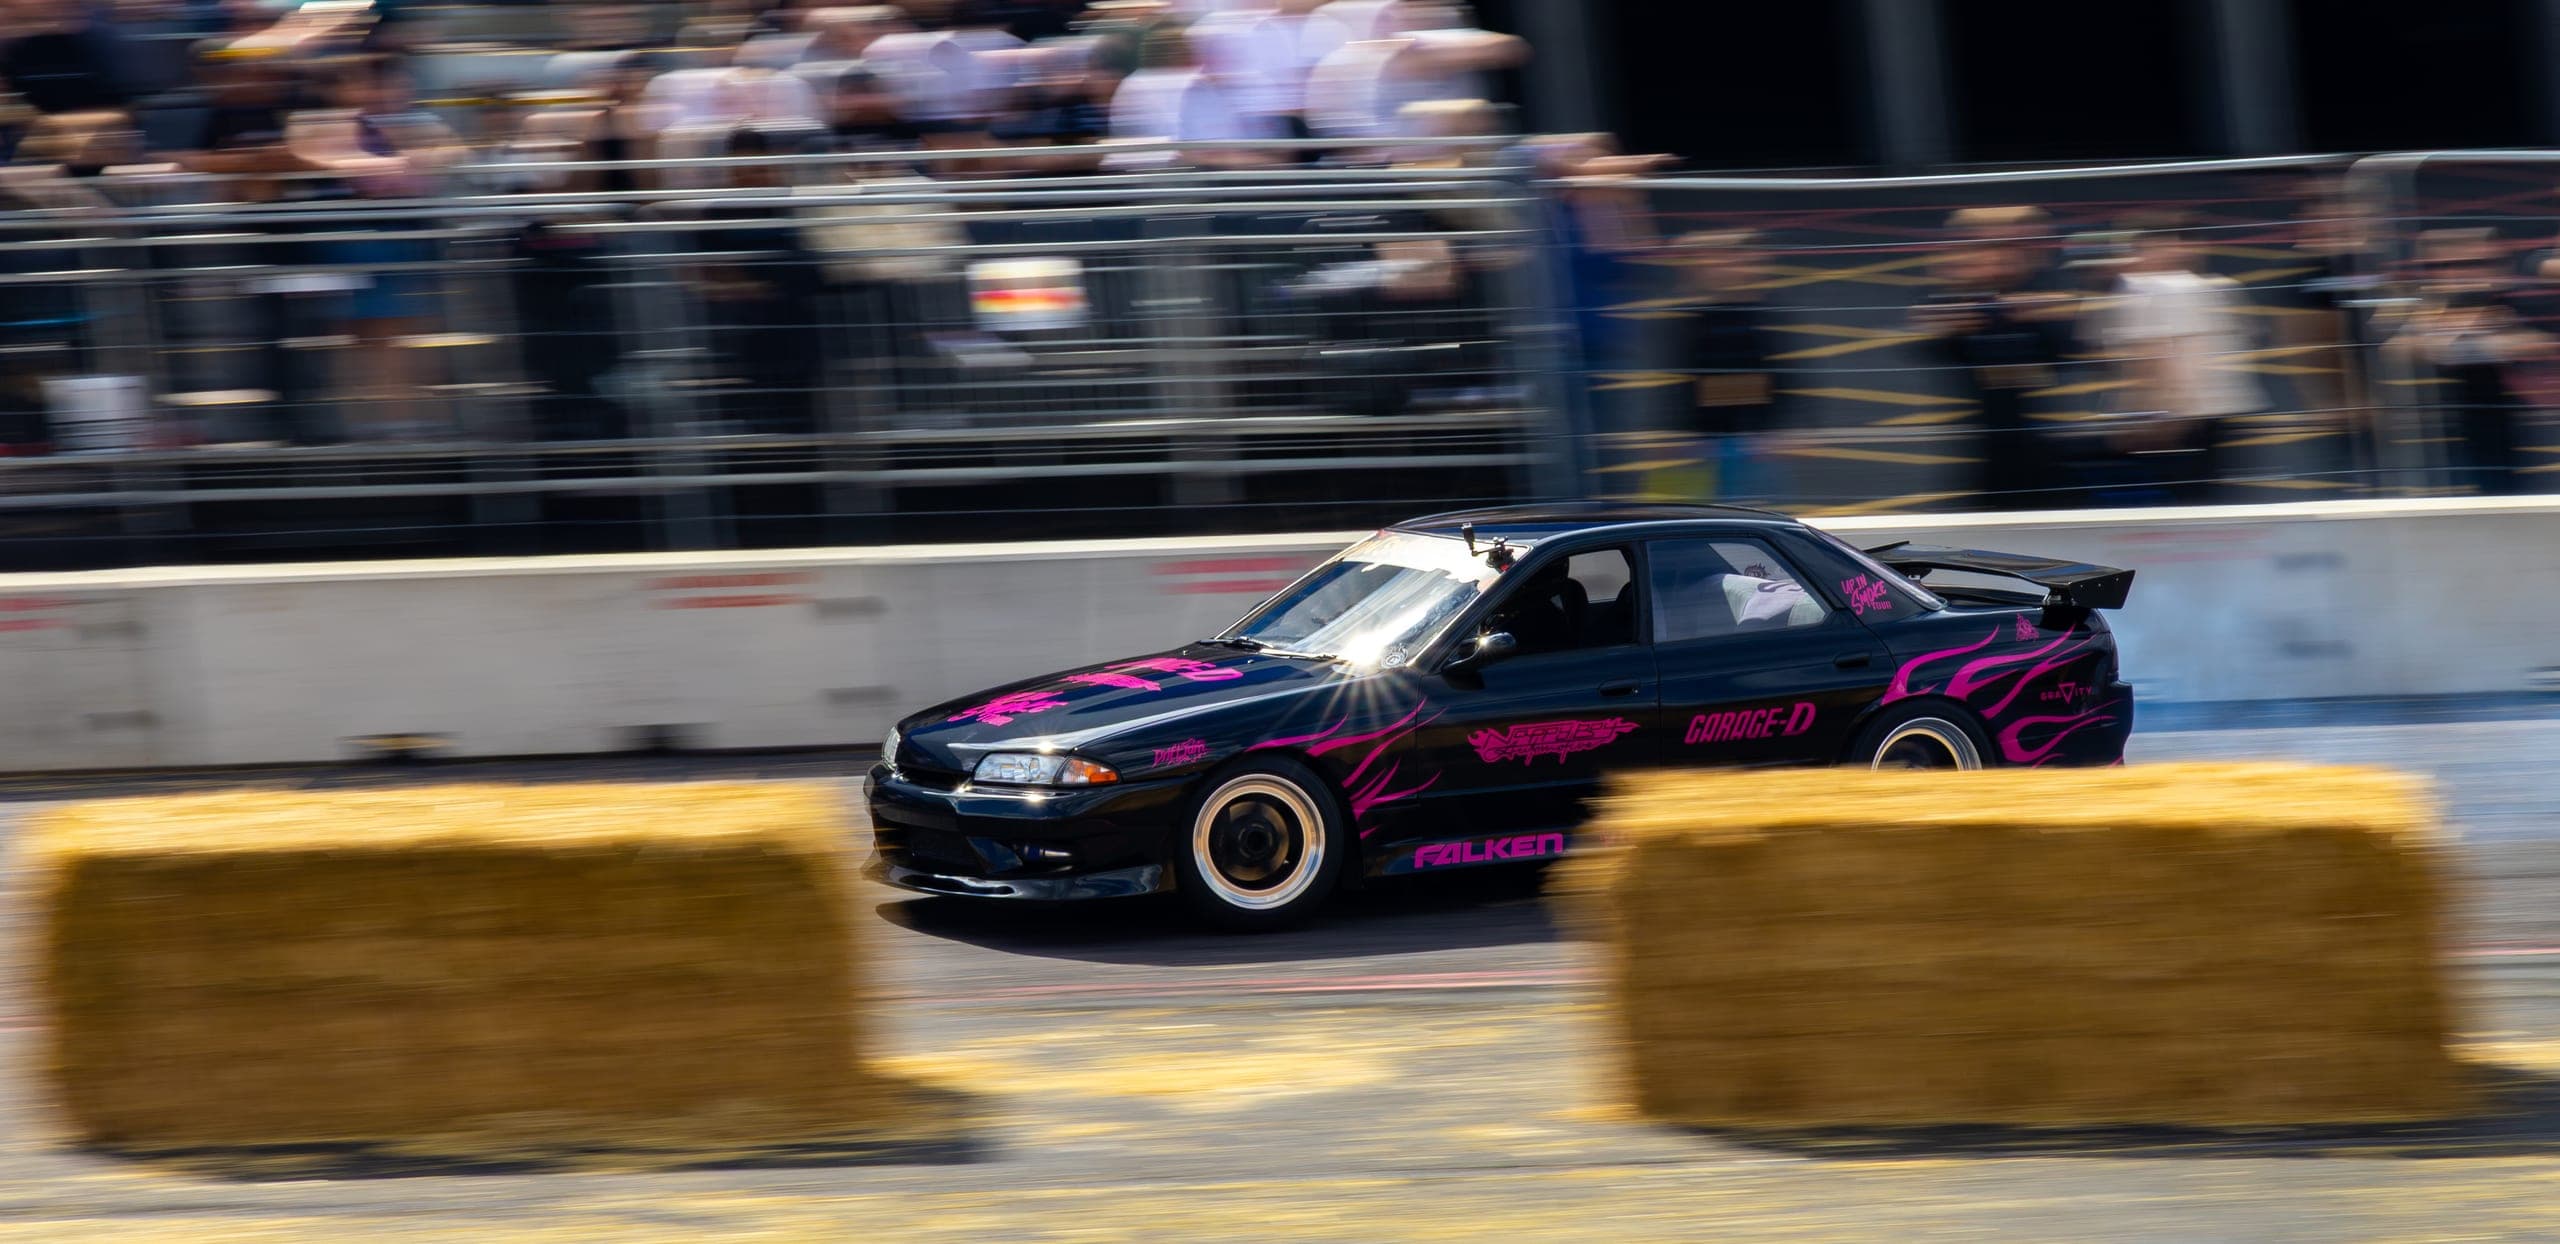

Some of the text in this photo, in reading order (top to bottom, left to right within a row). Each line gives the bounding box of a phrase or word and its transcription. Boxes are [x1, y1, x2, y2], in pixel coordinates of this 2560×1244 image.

[1841, 579, 1854, 595] UP
[1684, 702, 1817, 744] GARAGE-D
[1414, 833, 1564, 869] FALKEN
